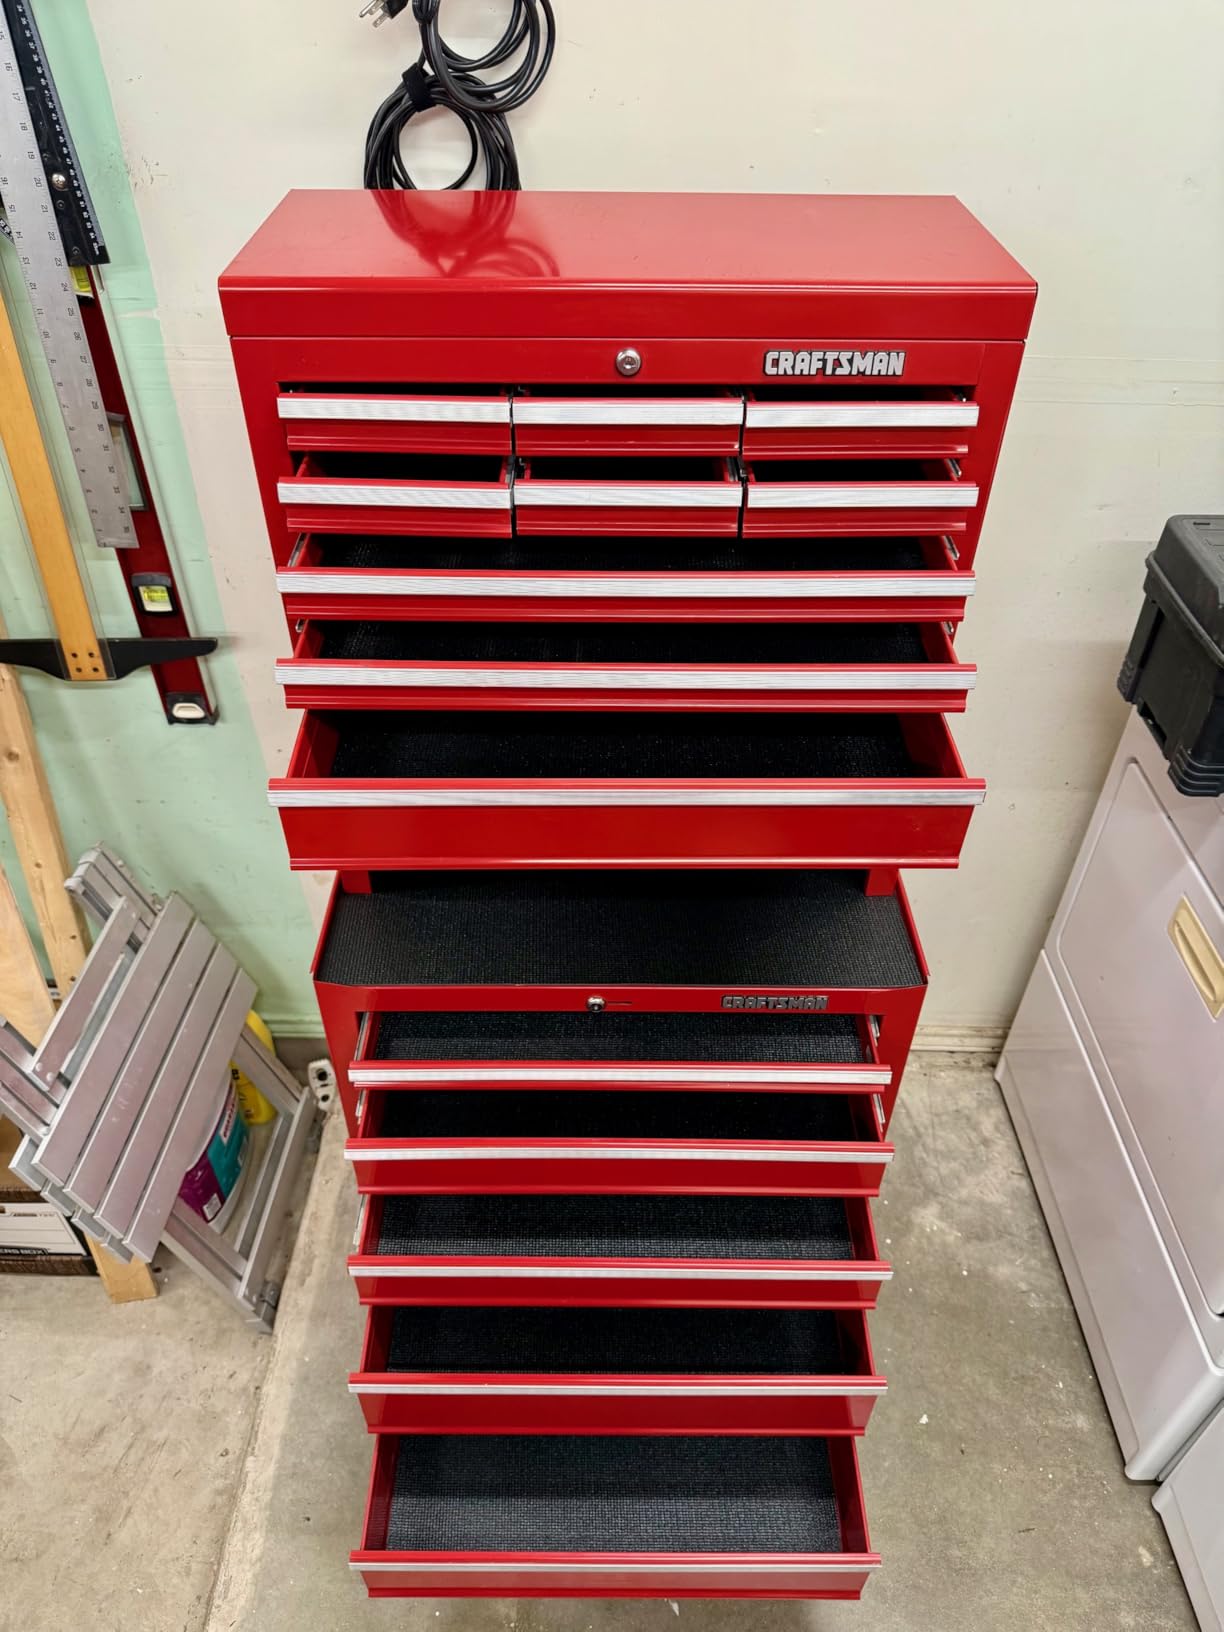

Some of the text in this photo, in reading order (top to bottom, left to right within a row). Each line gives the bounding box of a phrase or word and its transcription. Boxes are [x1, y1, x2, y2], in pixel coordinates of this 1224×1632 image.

[4, 62, 12, 72] 16
[12, 93, 20, 101] 17
[20, 122, 28, 131] 18
[28, 151, 35, 159] 19
[34, 177, 42, 187] 20
[41, 205, 48, 213] 21
[48, 231, 56, 241] 22
[55, 258, 62, 267] 23
[61, 283, 69, 292] 24
[67, 308, 74, 316] 25
[764, 351, 906, 376] CRAFTSMAN
[721, 995, 829, 1010] CRAFTSMAN
